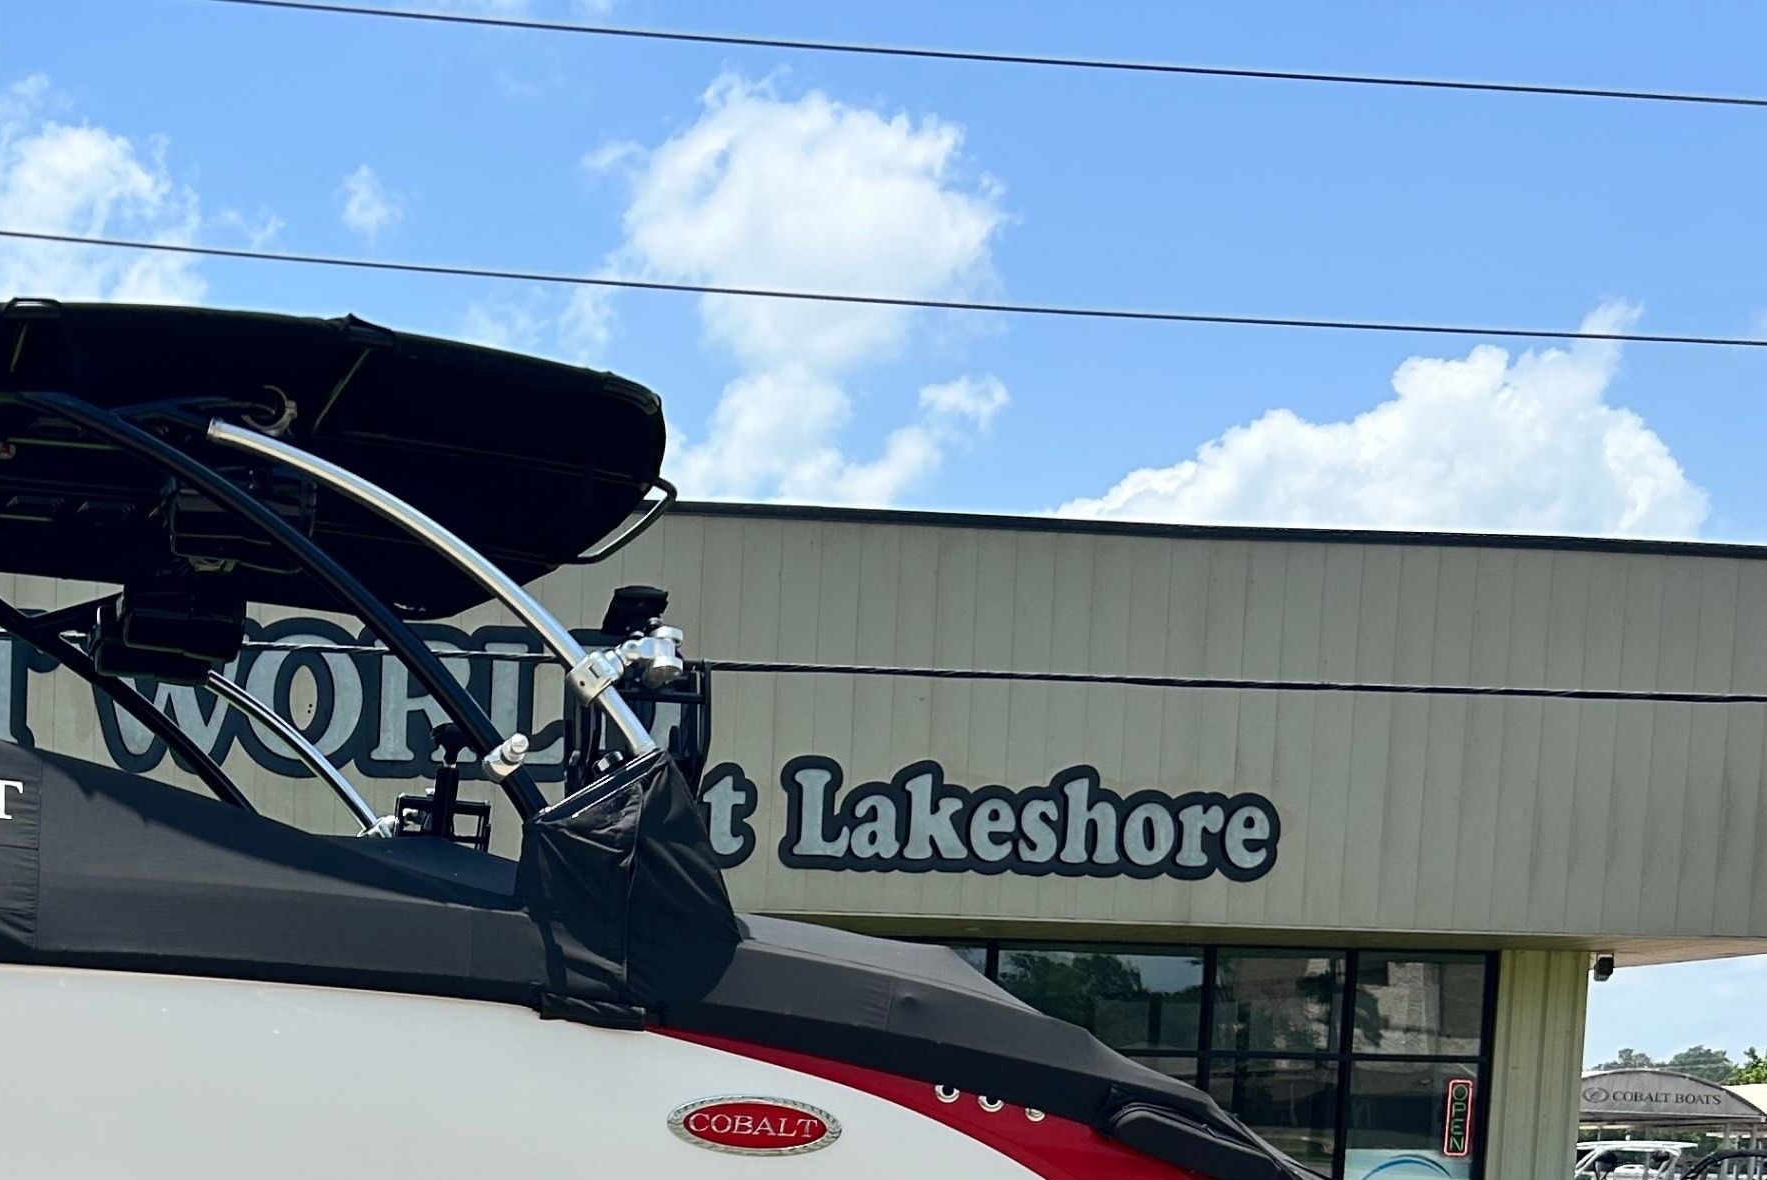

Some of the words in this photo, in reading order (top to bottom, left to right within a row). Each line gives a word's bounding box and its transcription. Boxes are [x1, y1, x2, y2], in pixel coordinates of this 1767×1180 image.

[791, 768, 1271, 869] Lakeshore
[1448, 1084, 1469, 1151] OPEN
[1612, 1091, 1671, 1104] COBALT
[1674, 1093, 1722, 1106] BOATS
[688, 1112, 819, 1138] COBALT
